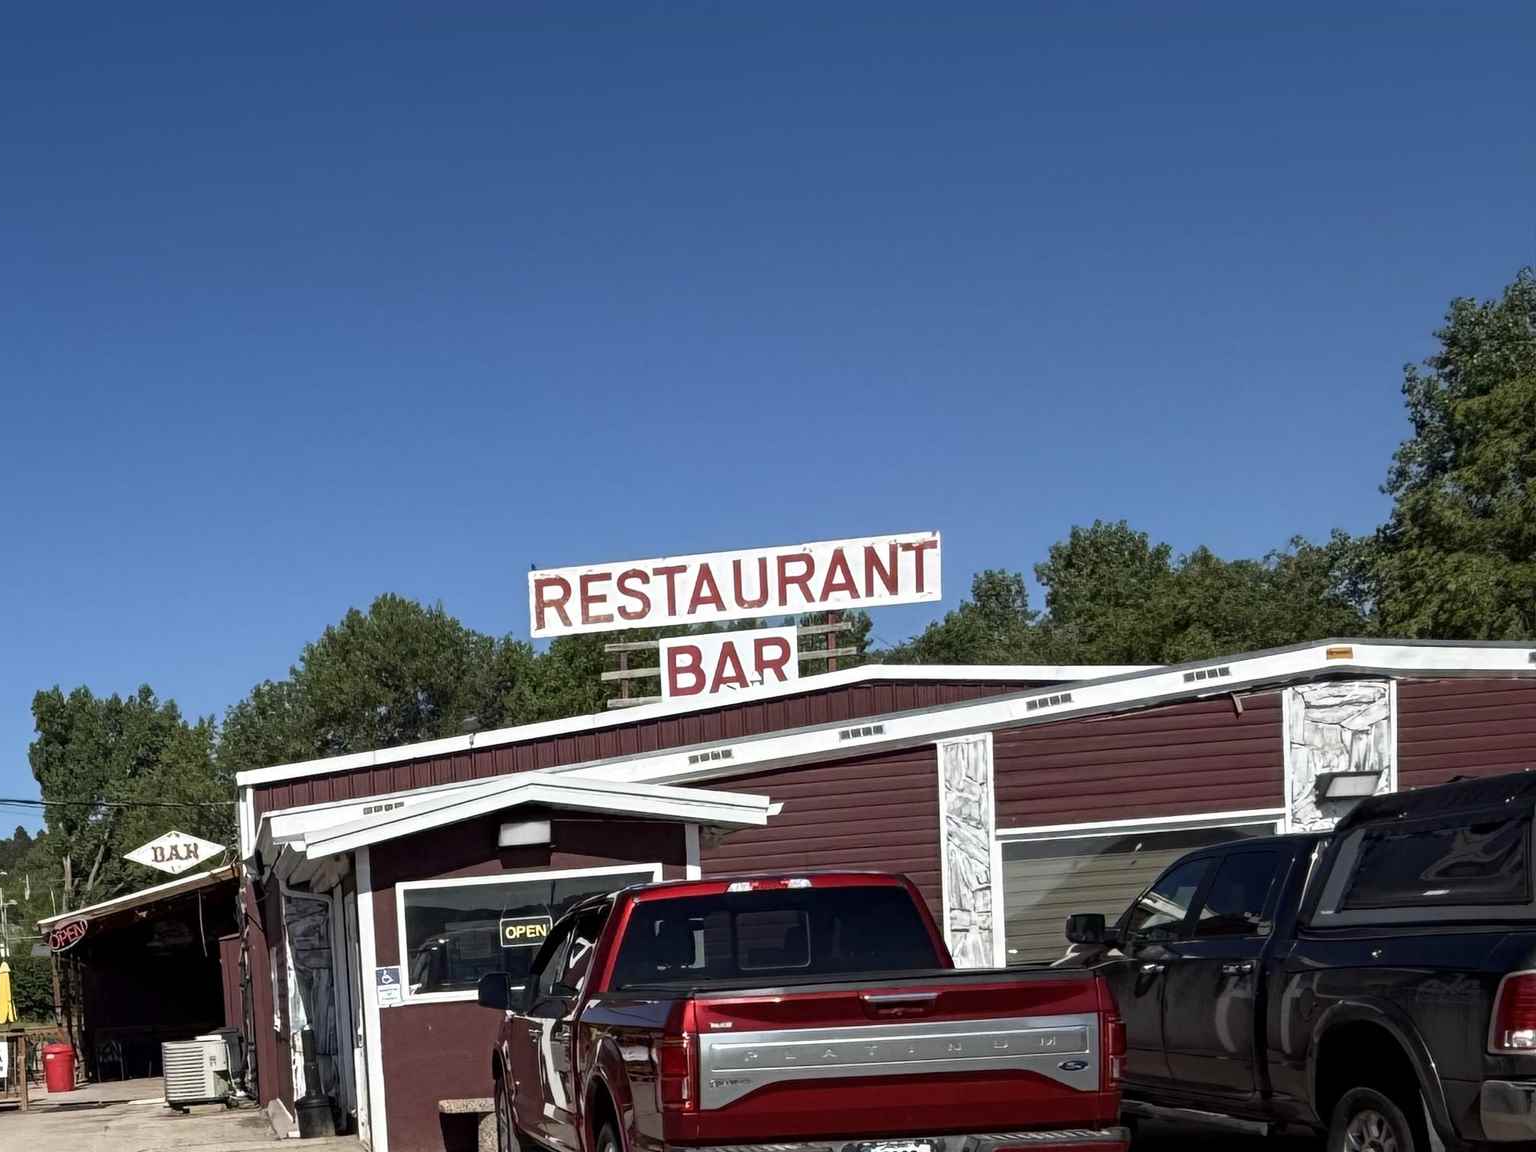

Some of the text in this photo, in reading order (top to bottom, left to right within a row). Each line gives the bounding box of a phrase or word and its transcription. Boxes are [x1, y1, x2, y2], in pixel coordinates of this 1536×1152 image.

[534, 540, 938, 631] RESTAURANT
[667, 636, 791, 698] BAR
[49, 921, 84, 949] OPEN
[505, 923, 547, 939] OPEN
